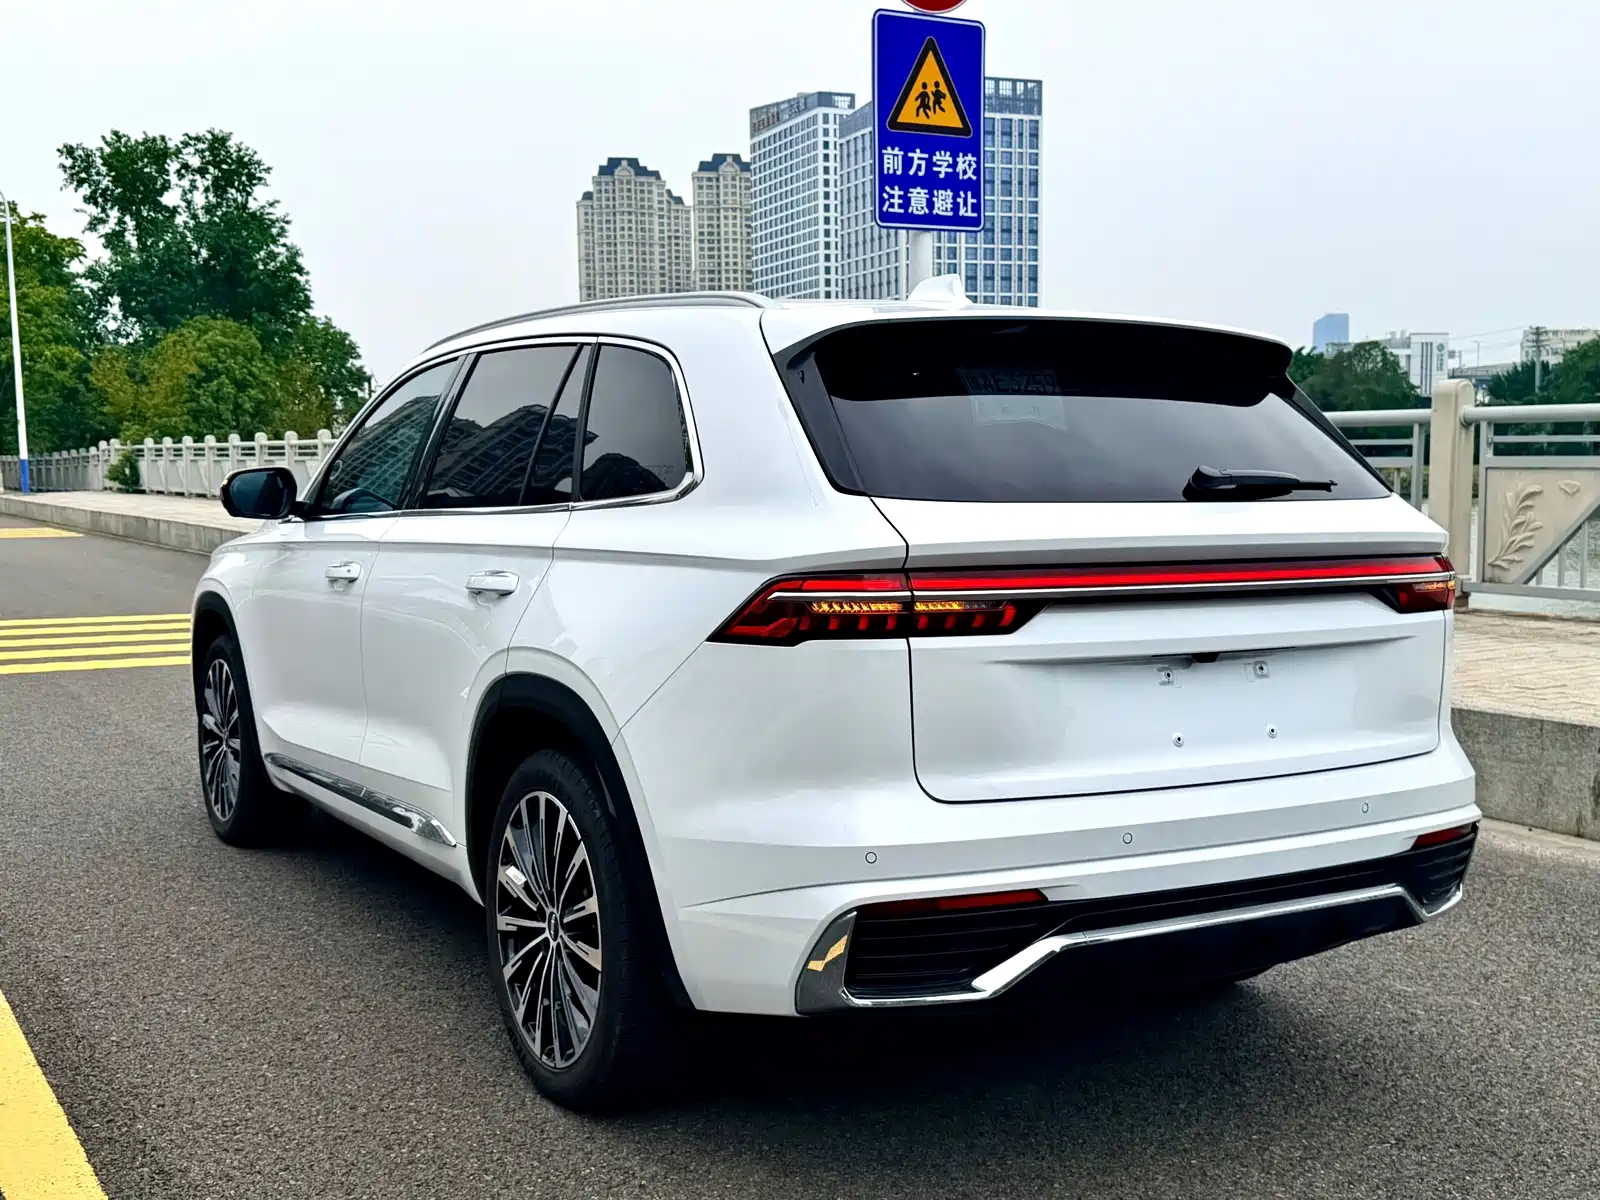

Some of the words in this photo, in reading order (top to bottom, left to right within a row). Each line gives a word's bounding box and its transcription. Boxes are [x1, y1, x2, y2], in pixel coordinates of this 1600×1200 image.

[881, 146, 978, 181] 前方学校
[882, 185, 978, 217] 注意避让
